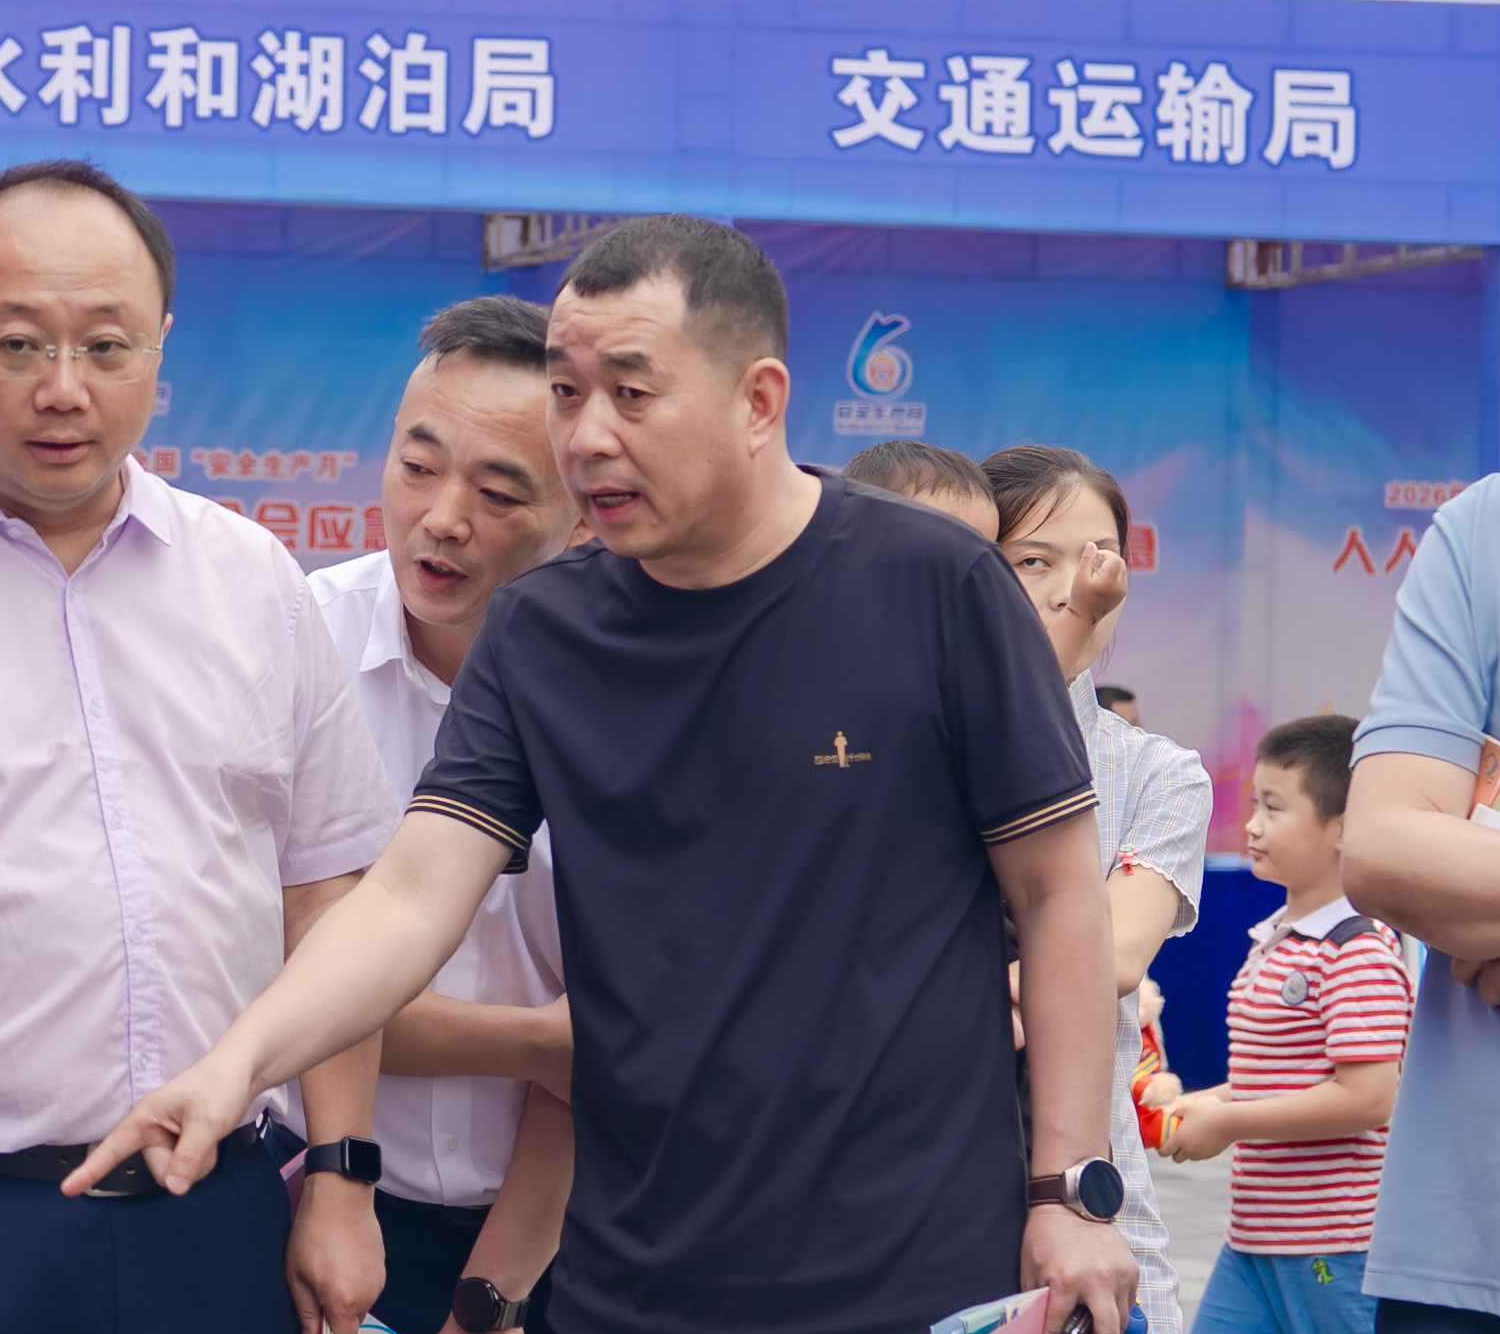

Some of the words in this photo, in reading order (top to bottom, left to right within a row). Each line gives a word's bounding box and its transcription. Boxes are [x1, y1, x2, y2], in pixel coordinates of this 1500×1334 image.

[831, 49, 1358, 169] 交通运输局
